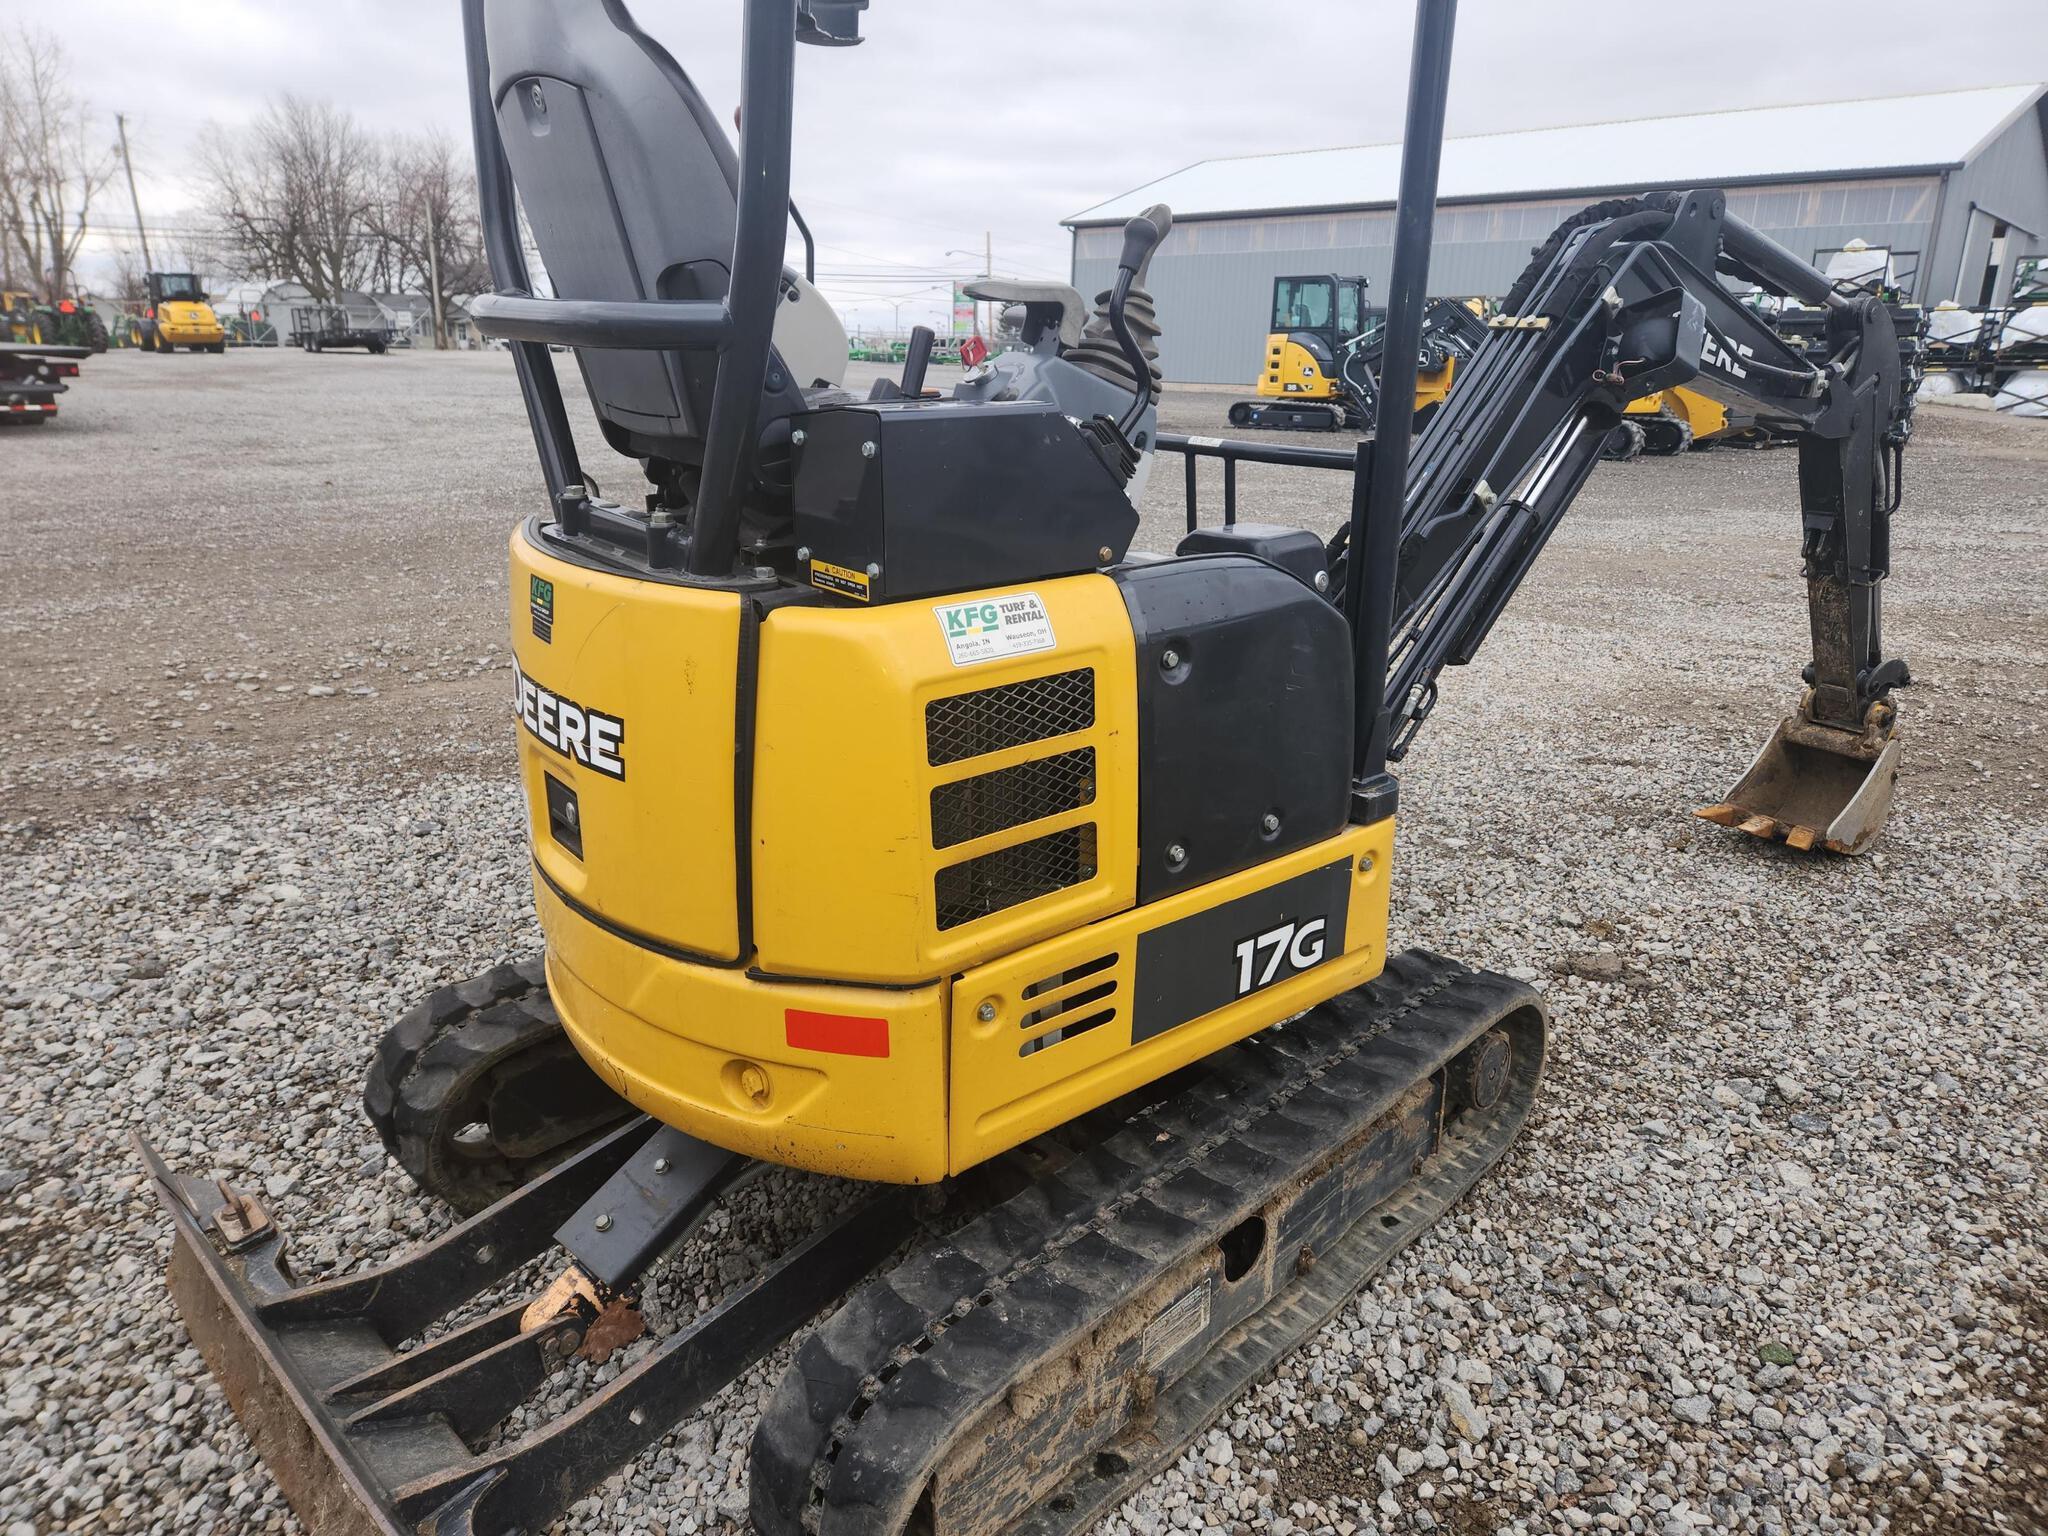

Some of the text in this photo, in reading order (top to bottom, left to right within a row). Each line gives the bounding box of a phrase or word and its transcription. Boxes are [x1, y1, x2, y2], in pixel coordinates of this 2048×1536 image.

[831, 566, 856, 580] CAUTION
[531, 576, 552, 601] KFG
[1000, 599, 1038, 614] TURF &
[946, 604, 998, 631] KFG
[1004, 610, 1044, 626] RENTAL
[956, 640, 981, 650] Angola,
[1236, 918, 1326, 995] 17G
